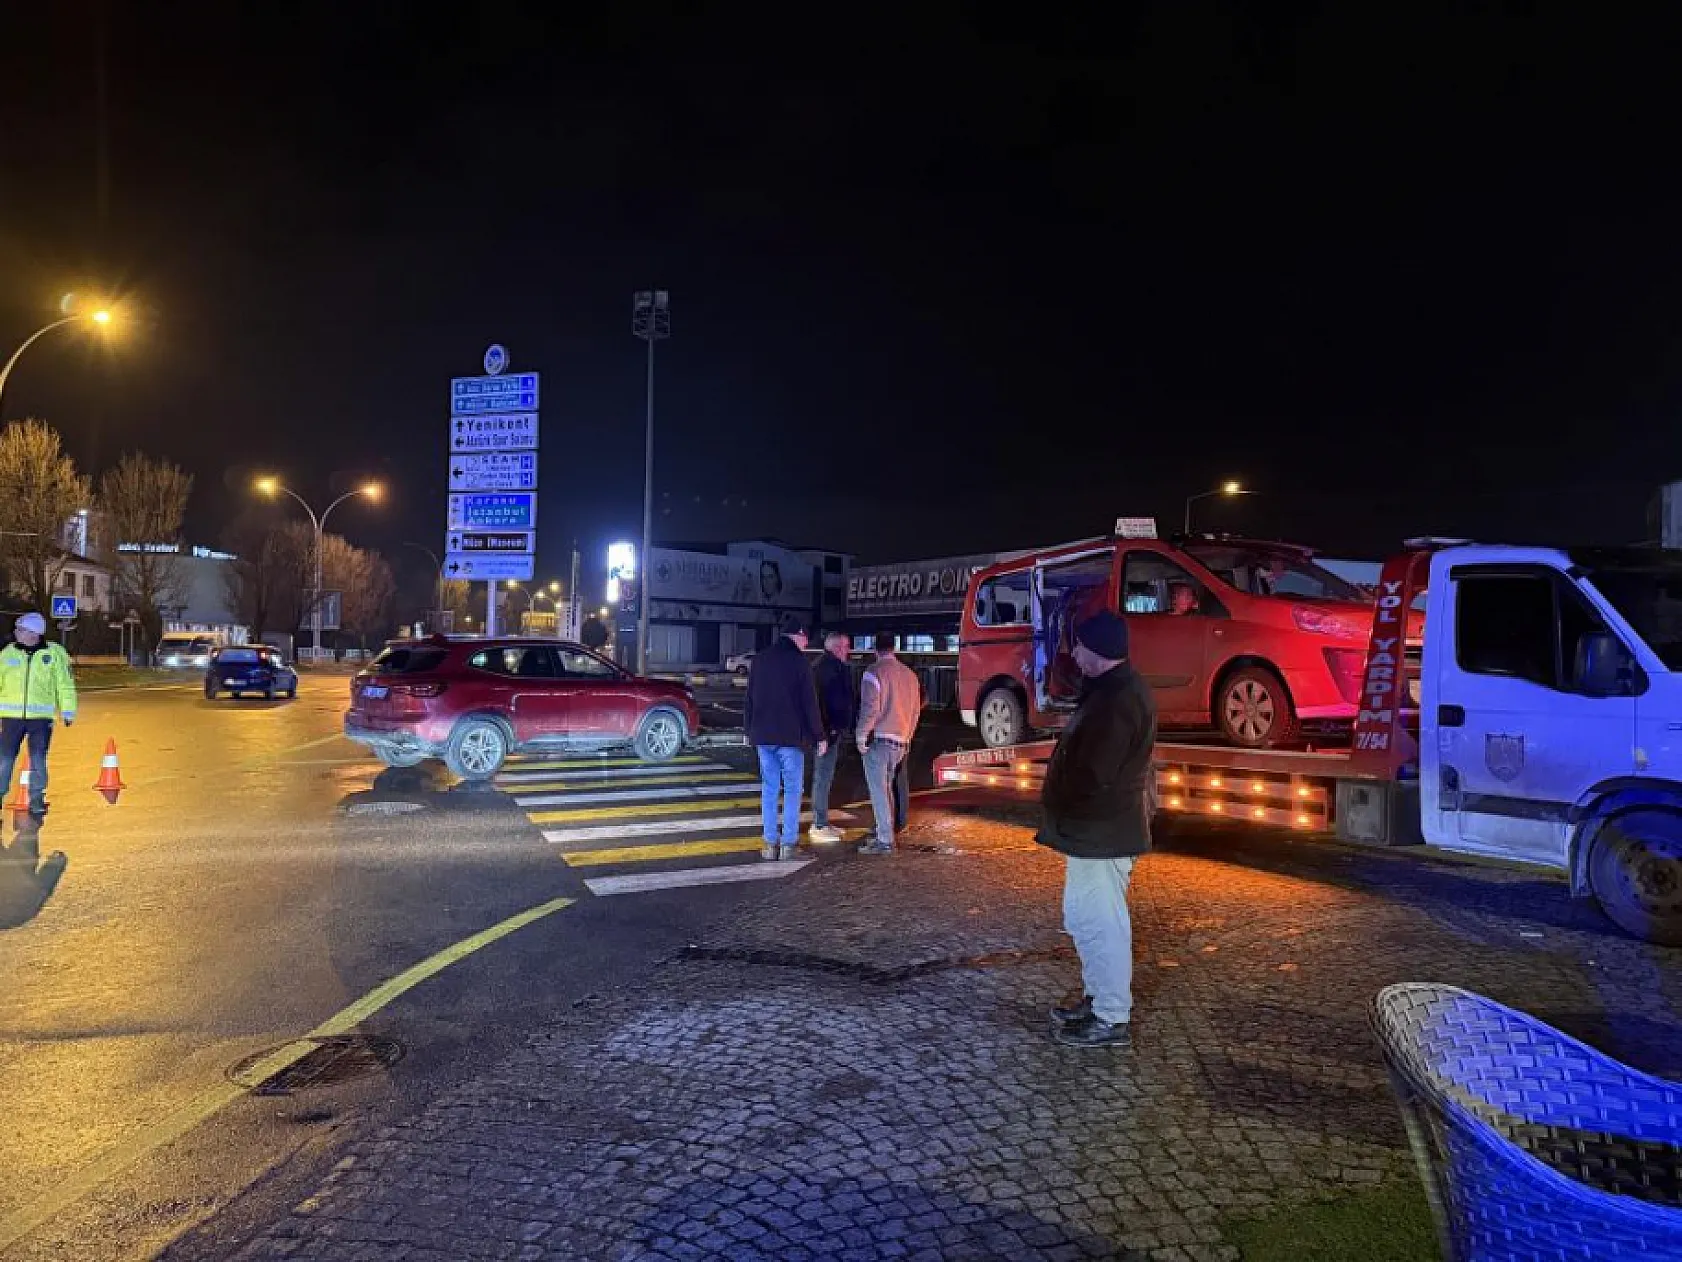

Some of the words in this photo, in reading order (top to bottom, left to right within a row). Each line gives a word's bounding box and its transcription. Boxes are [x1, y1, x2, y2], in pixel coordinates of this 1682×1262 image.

[848, 573, 921, 599] ELECTRO
[1379, 580, 1403, 623] YOL
[1359, 637, 1399, 724] YARDIM
